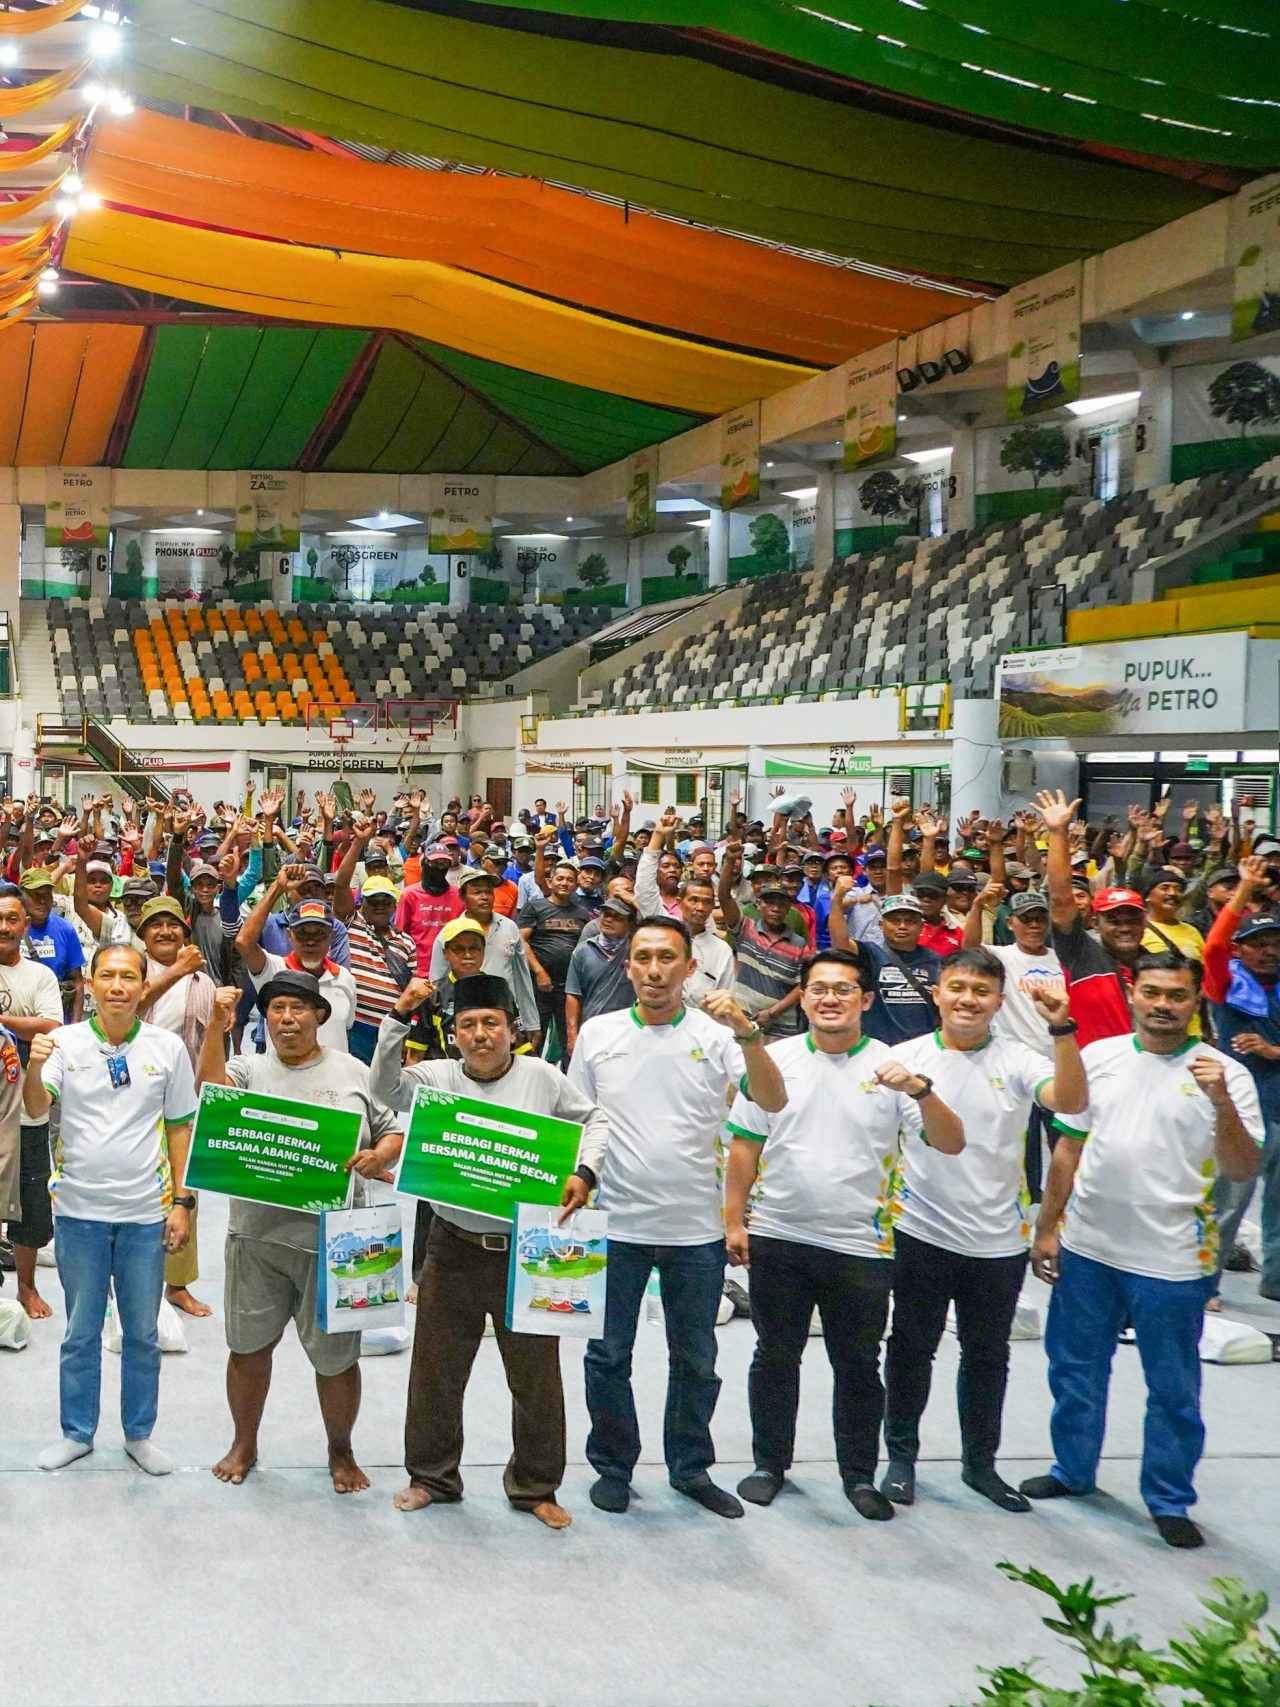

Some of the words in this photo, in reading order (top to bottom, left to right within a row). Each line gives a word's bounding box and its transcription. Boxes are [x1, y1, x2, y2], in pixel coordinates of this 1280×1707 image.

[63, 479, 93, 487] PETRO
[444, 487, 480, 496] PETRO
[155, 548, 195, 557] PHONSKA
[96, 555, 107, 572] C
[279, 558, 290, 575] C
[456, 561, 467, 578] C
[1147, 687, 1219, 711] PETRO
[830, 744, 856, 755] PETRO
[144, 758, 163, 766] PLUS
[308, 759, 384, 769] PHOSGREEN
[829, 757, 847, 775] ZA
[228, 1126, 276, 1142] BERBAGI
[277, 1133, 321, 1153] BERKAH
[442, 1131, 492, 1150] BERBAGI
[494, 1142, 540, 1163] BERKAH
[207, 1138, 260, 1154] BERSAMA
[261, 1146, 300, 1162] ABANG
[302, 1154, 339, 1172] BECAK
[421, 1142, 476, 1161] BERSAMA
[478, 1153, 519, 1171] ABANG
[520, 1164, 558, 1185] BECAK
